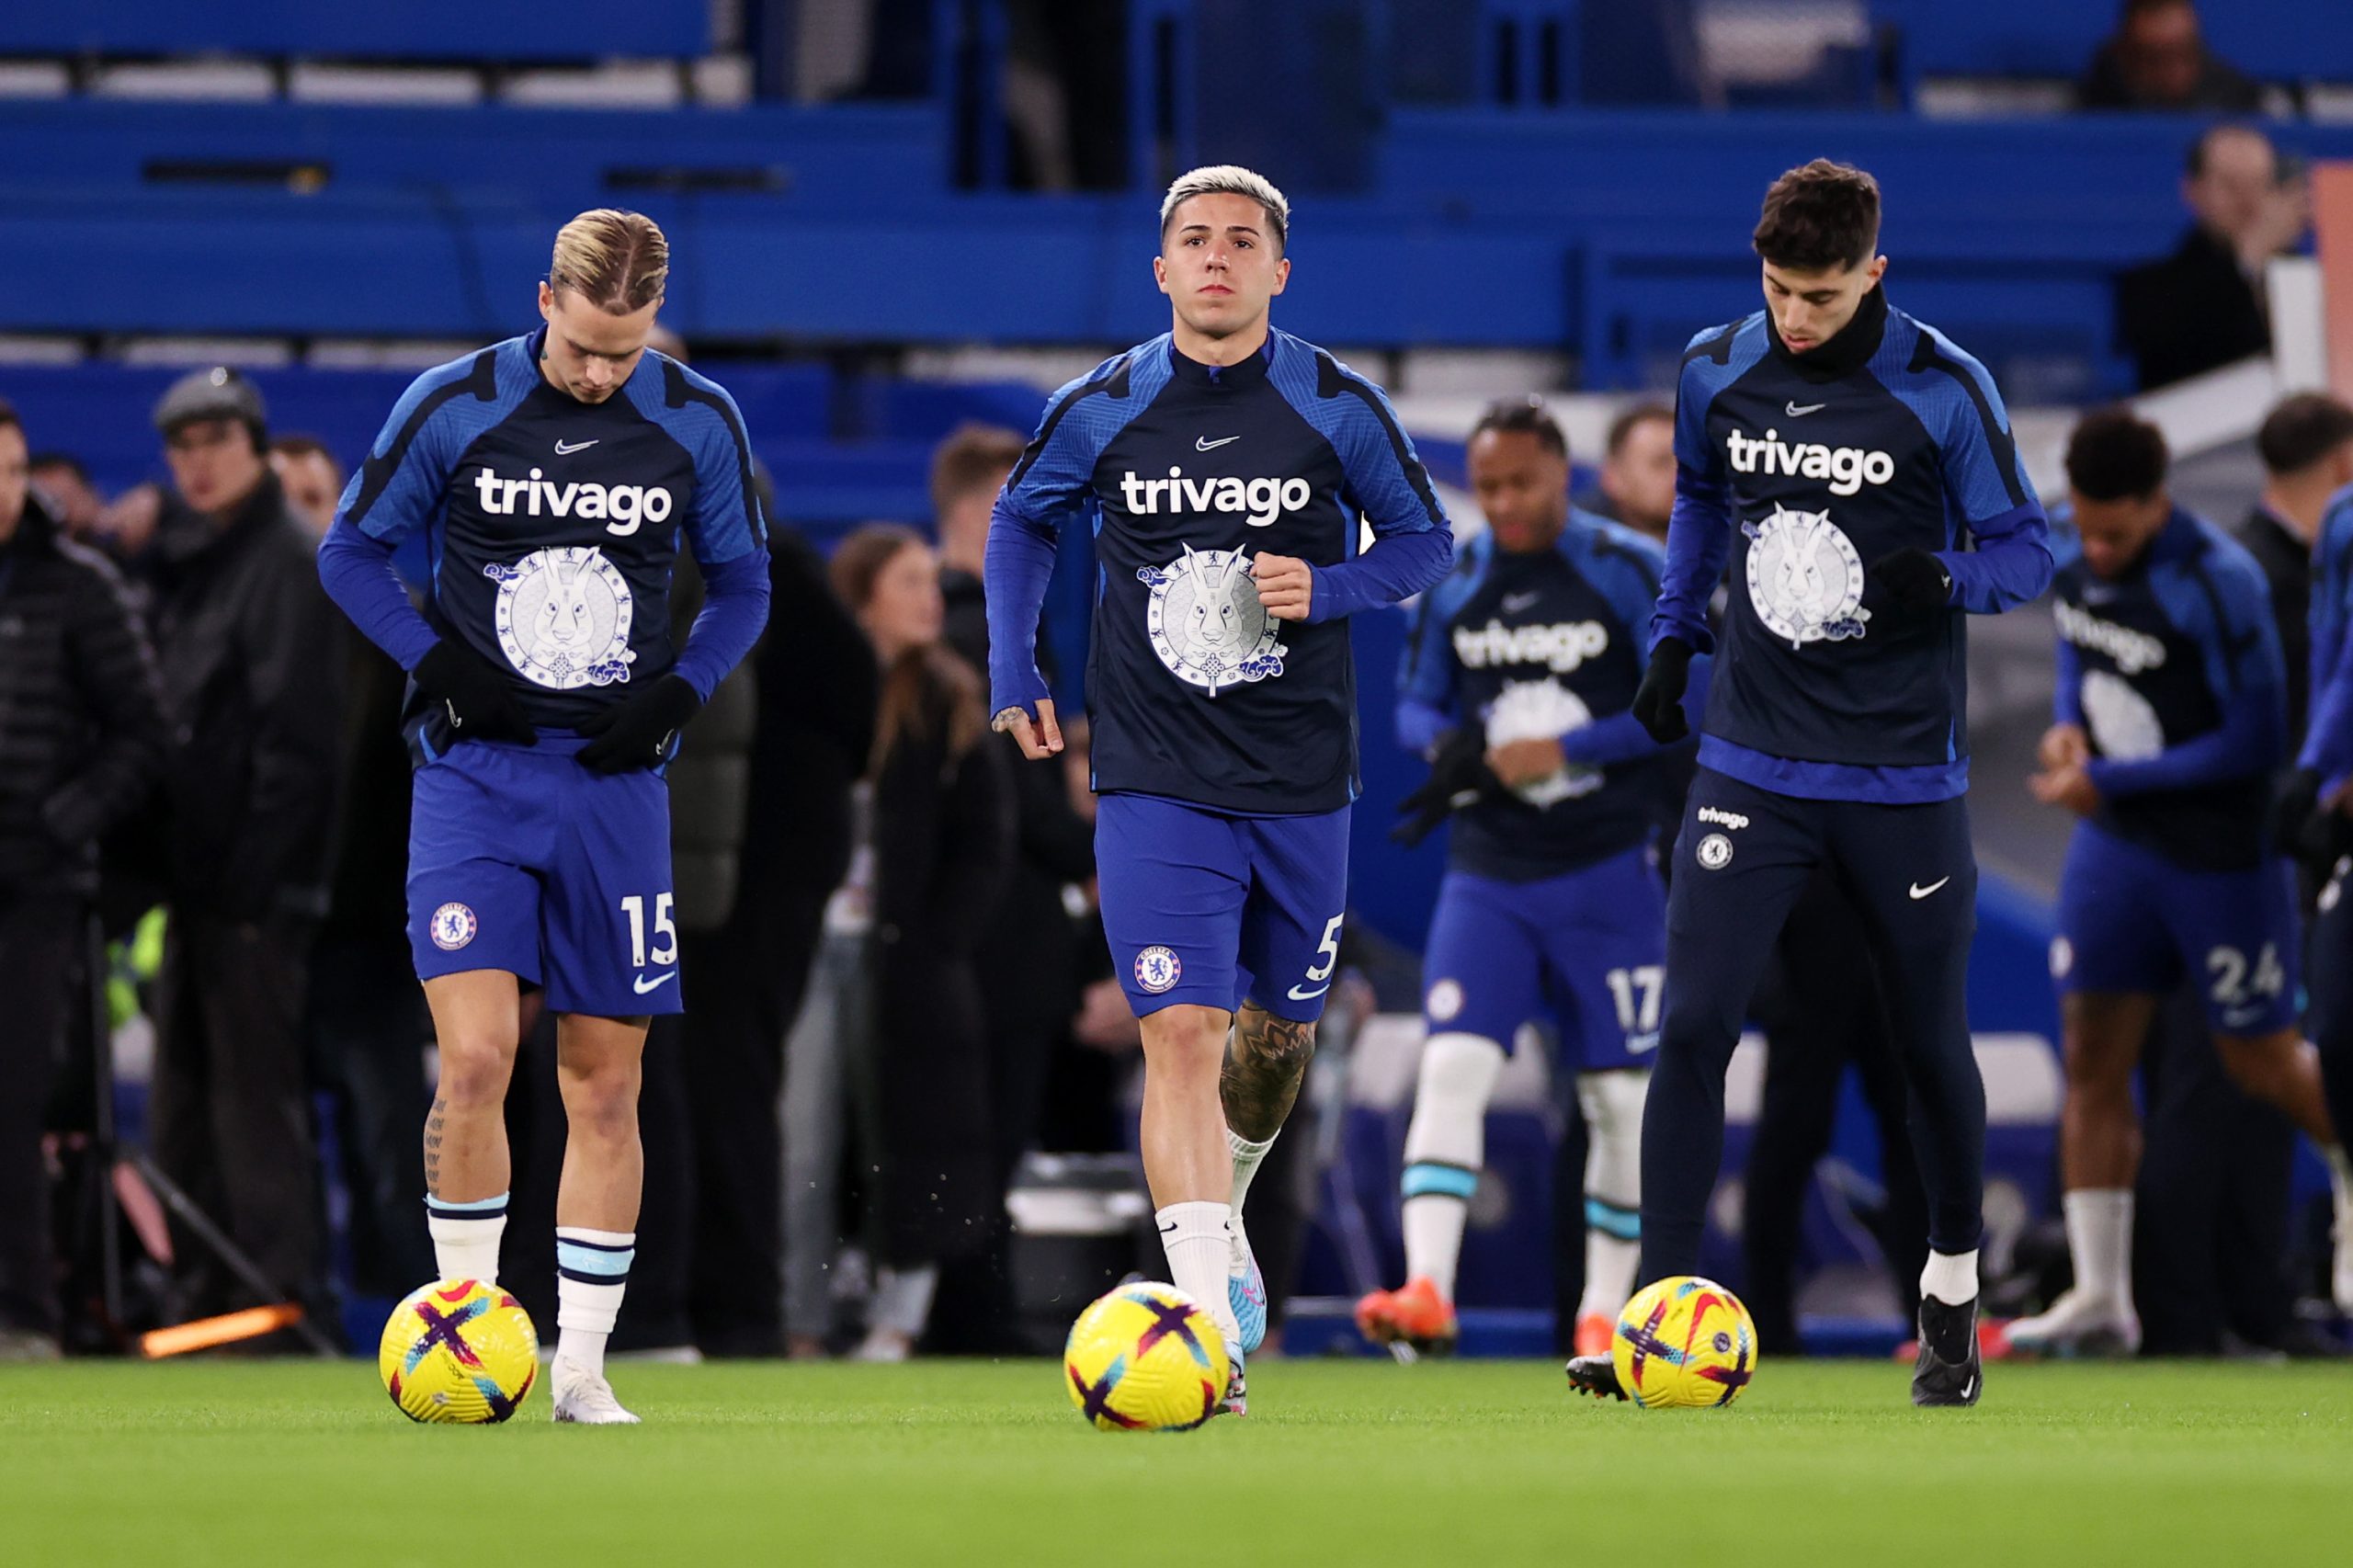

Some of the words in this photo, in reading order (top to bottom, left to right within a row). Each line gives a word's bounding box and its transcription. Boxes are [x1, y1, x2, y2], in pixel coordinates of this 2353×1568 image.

[1727, 428, 1894, 496] trivago
[474, 467, 672, 536] trivago
[1120, 466, 1311, 527] trivago
[1453, 618, 1608, 673] trivago
[1698, 806, 1749, 830] trivago
[621, 892, 677, 967] 15
[1305, 912, 1344, 982] 5
[1606, 965, 1665, 1031] 17
[2207, 942, 2284, 1005] 24
